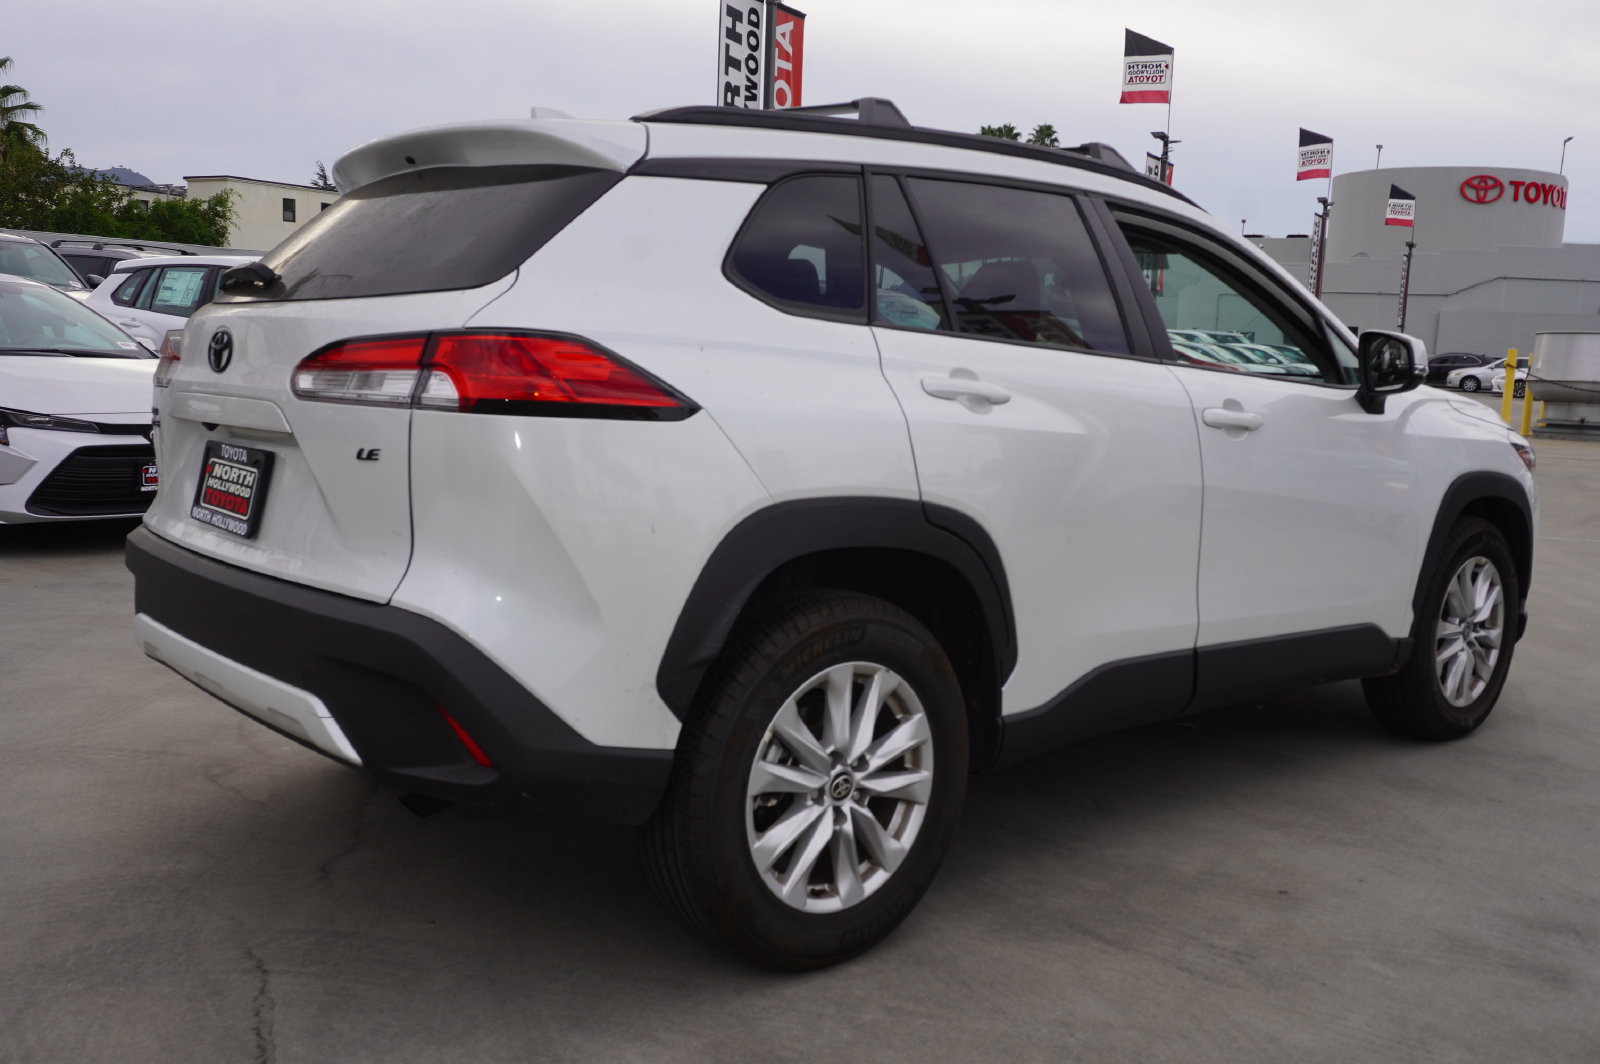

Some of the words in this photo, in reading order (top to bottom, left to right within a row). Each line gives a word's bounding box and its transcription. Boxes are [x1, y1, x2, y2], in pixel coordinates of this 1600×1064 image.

[221, 444, 247, 463] TOYOTA
[356, 448, 381, 461] LE
[212, 463, 256, 487] NORTH
[207, 477, 251, 498] HOLLYWOOD
[205, 487, 248, 515] TOYOTA
[192, 506, 212, 523] NORTH
[211, 512, 248, 536] HOLLYWOOD
